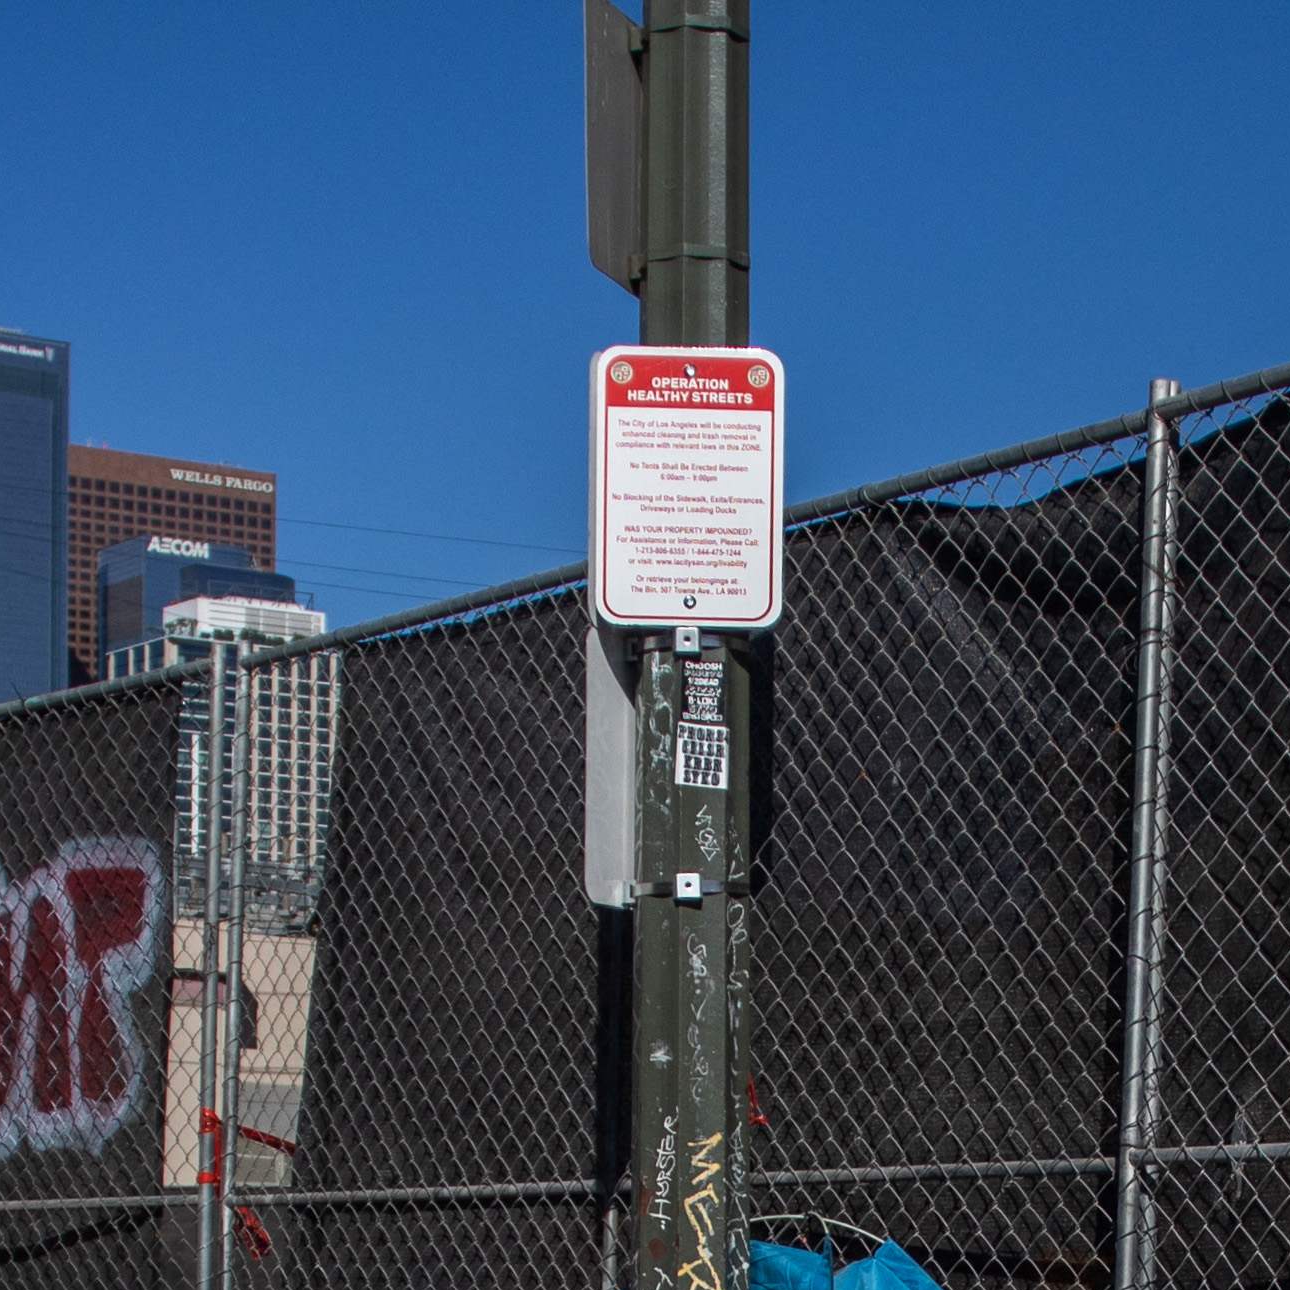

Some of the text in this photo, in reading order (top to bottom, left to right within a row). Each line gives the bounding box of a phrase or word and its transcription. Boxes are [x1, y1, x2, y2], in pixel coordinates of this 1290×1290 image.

[652, 377, 729, 390] OPERATION
[628, 390, 753, 404] HEALTHY STREETS
[632, 420, 645, 428] City
[656, 420, 668, 428] Los
[671, 421, 697, 430] Angeles
[723, 422, 761, 431] conducting
[622, 430, 655, 438] enhanced
[657, 432, 686, 440] cleaning
[721, 433, 748, 441] removal
[616, 441, 654, 450] compliance
[170, 468, 274, 493] WELLS FARGO
[147, 536, 210, 559] AECOM
